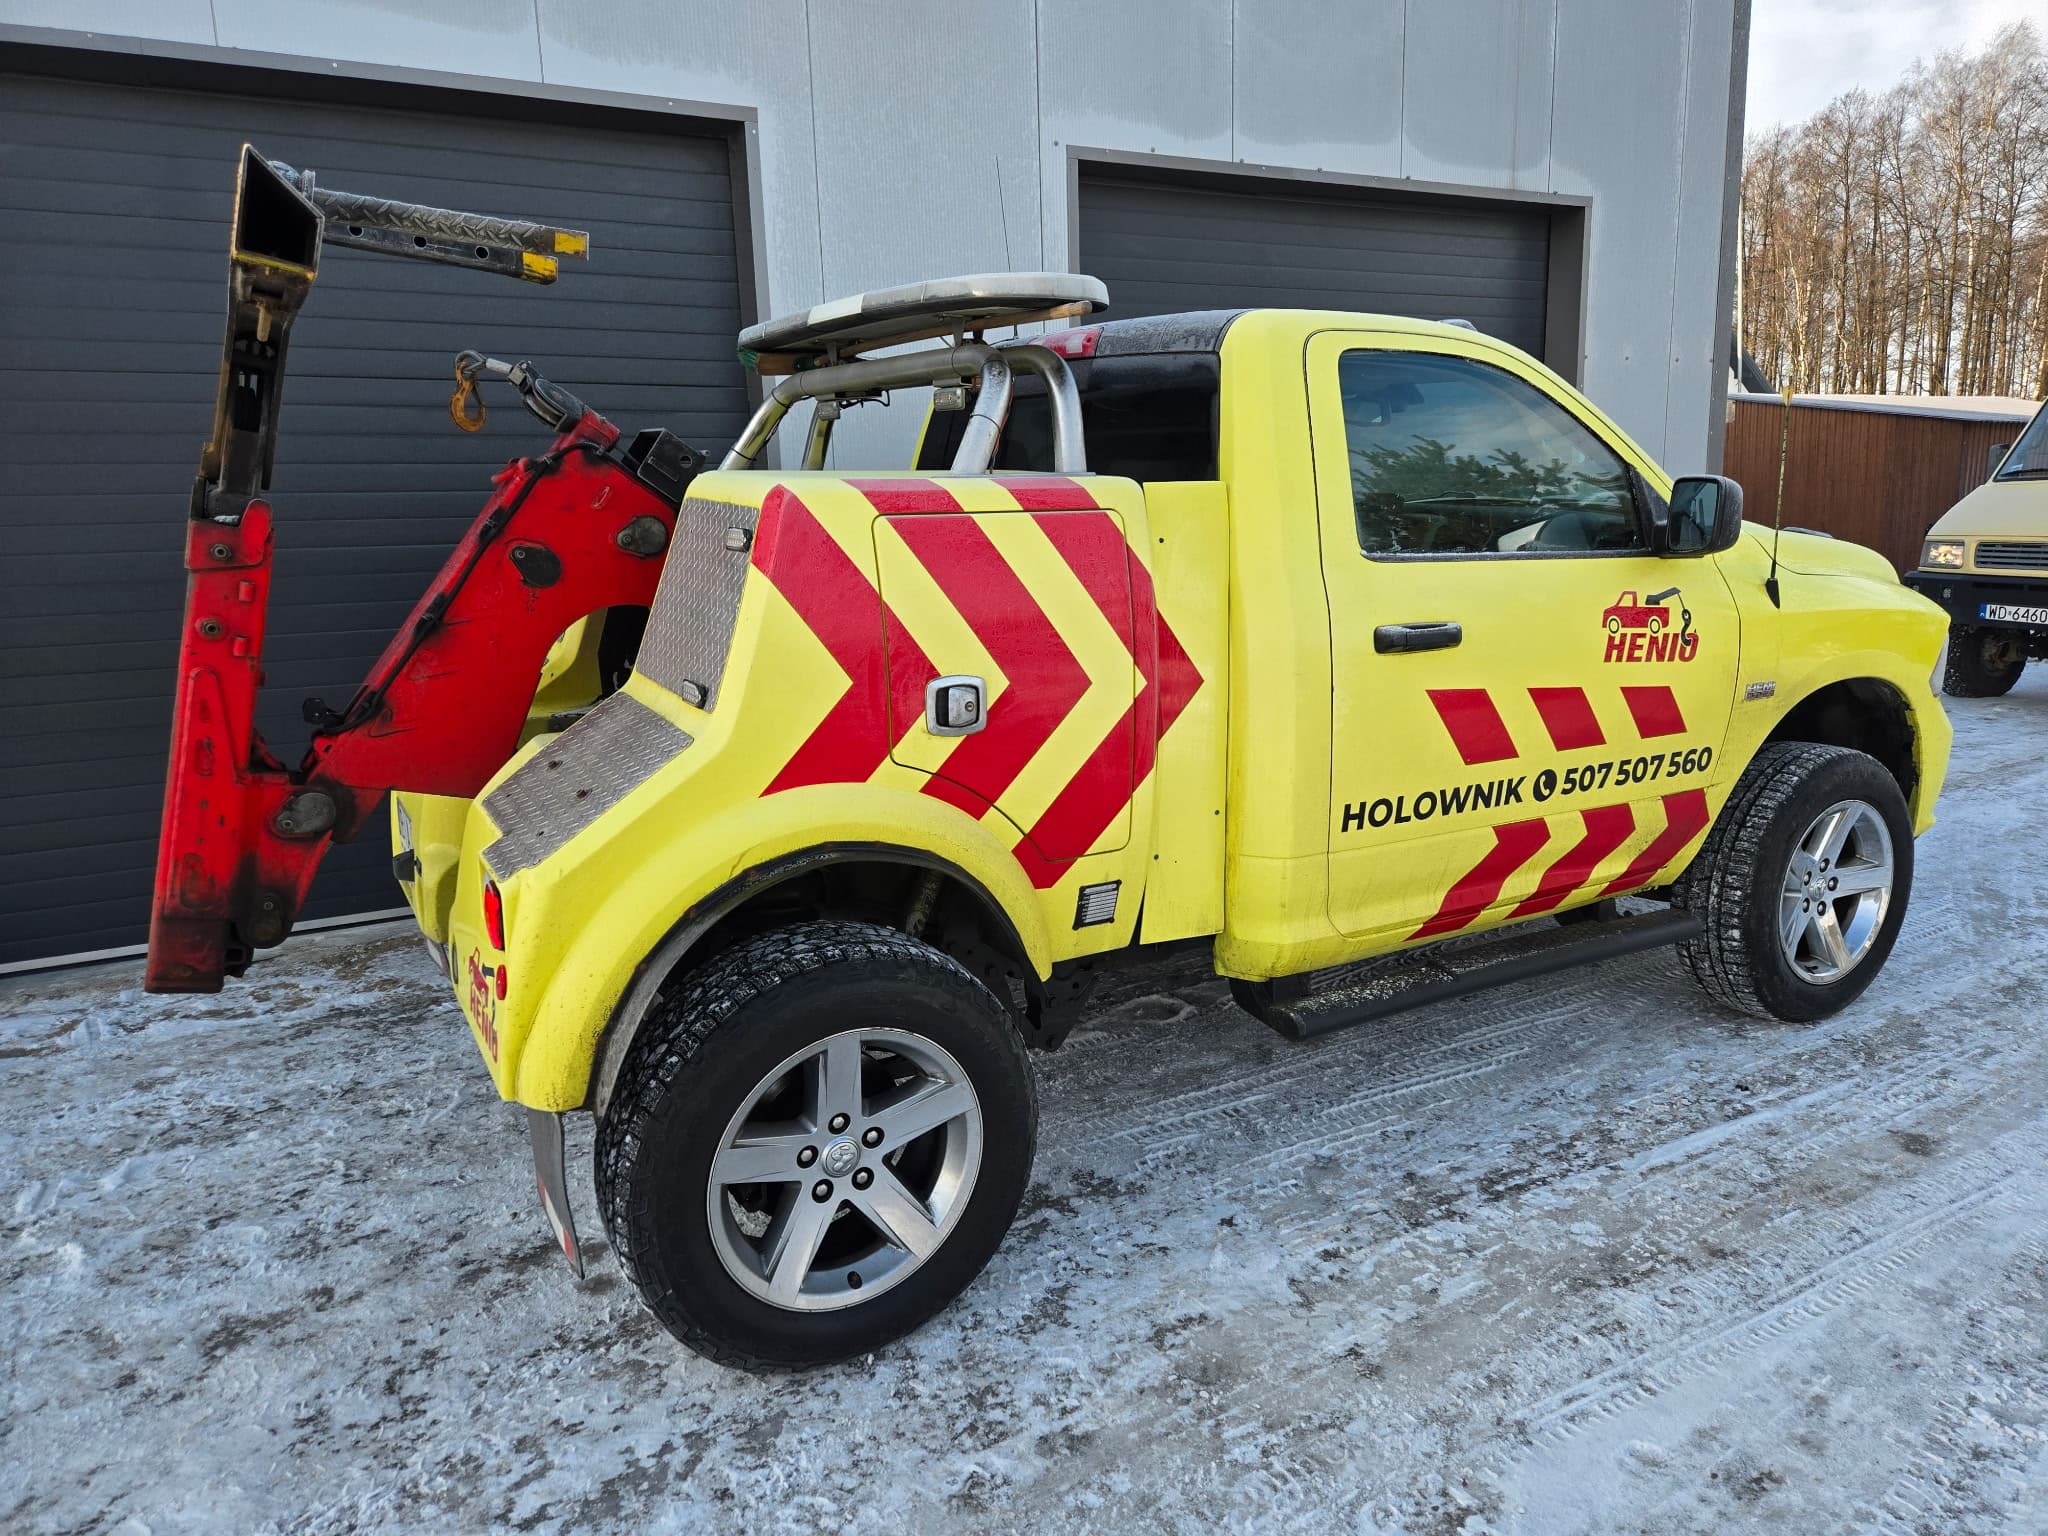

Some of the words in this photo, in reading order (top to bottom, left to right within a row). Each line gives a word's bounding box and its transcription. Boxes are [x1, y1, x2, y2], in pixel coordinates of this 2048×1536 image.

[1989, 605, 2007, 620] WD
[2012, 607, 2048, 623] 6460
[1603, 631, 1699, 663] HENIO
[1341, 775, 1527, 833] HOLOWNIK
[1560, 762, 1613, 796] 507
[1614, 754, 1665, 786] 507
[1666, 746, 1713, 778] 560
